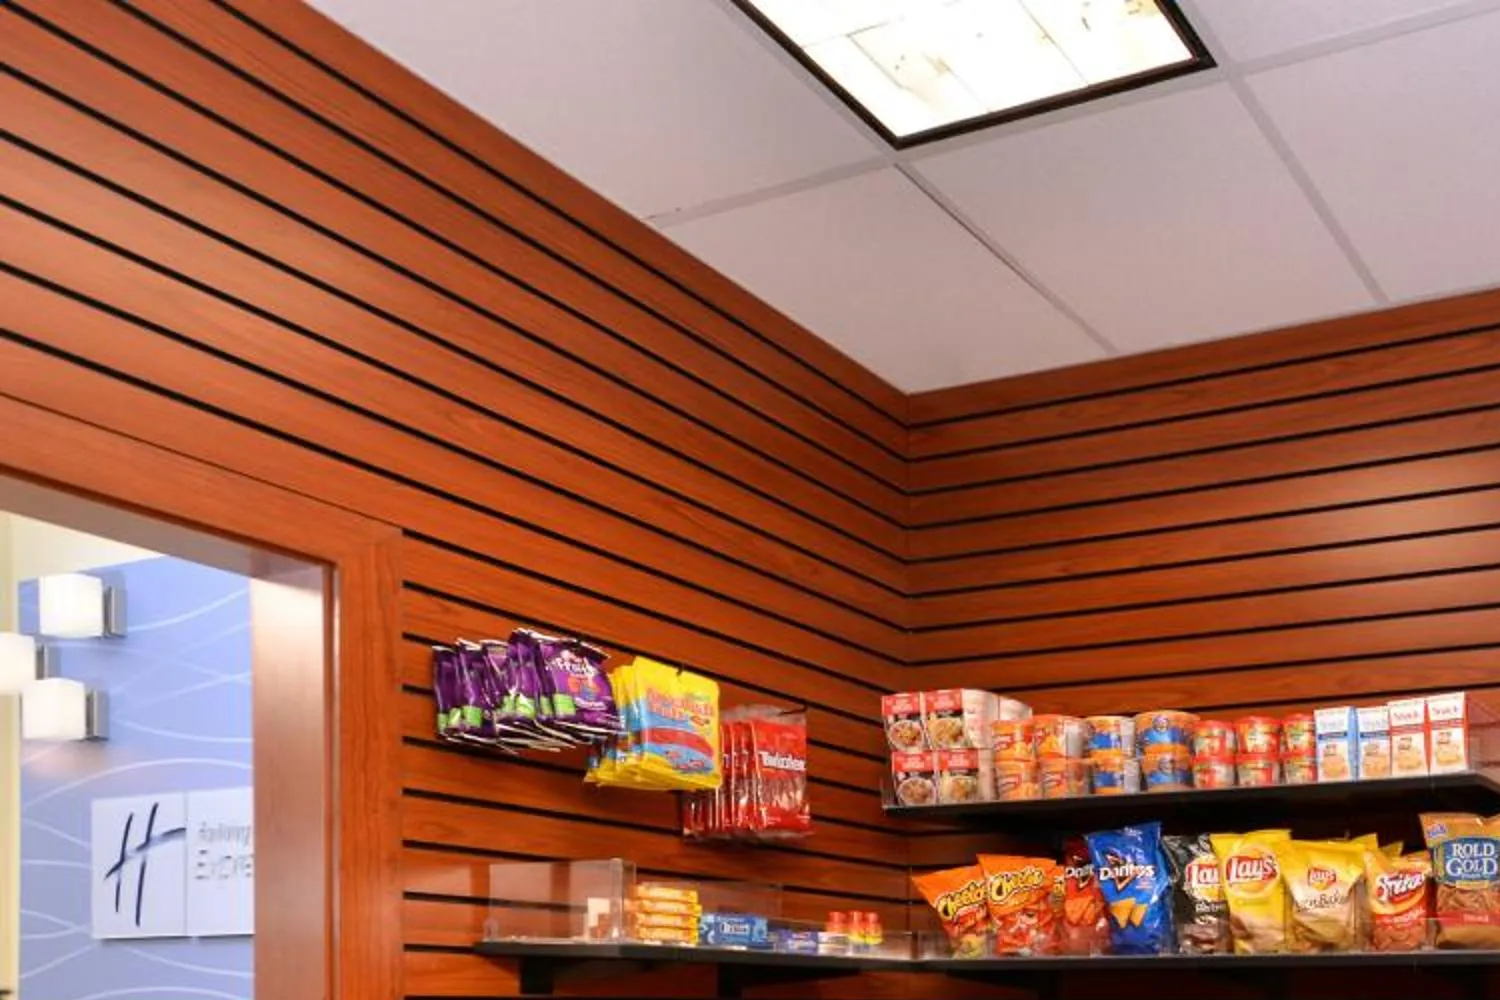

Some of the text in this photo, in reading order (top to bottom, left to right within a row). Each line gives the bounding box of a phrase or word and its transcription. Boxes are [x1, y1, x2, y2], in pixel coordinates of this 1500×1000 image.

[1452, 843, 1496, 858] ROLD
[1100, 862, 1156, 881] Doritos
[1446, 858, 1499, 876] GOLD
